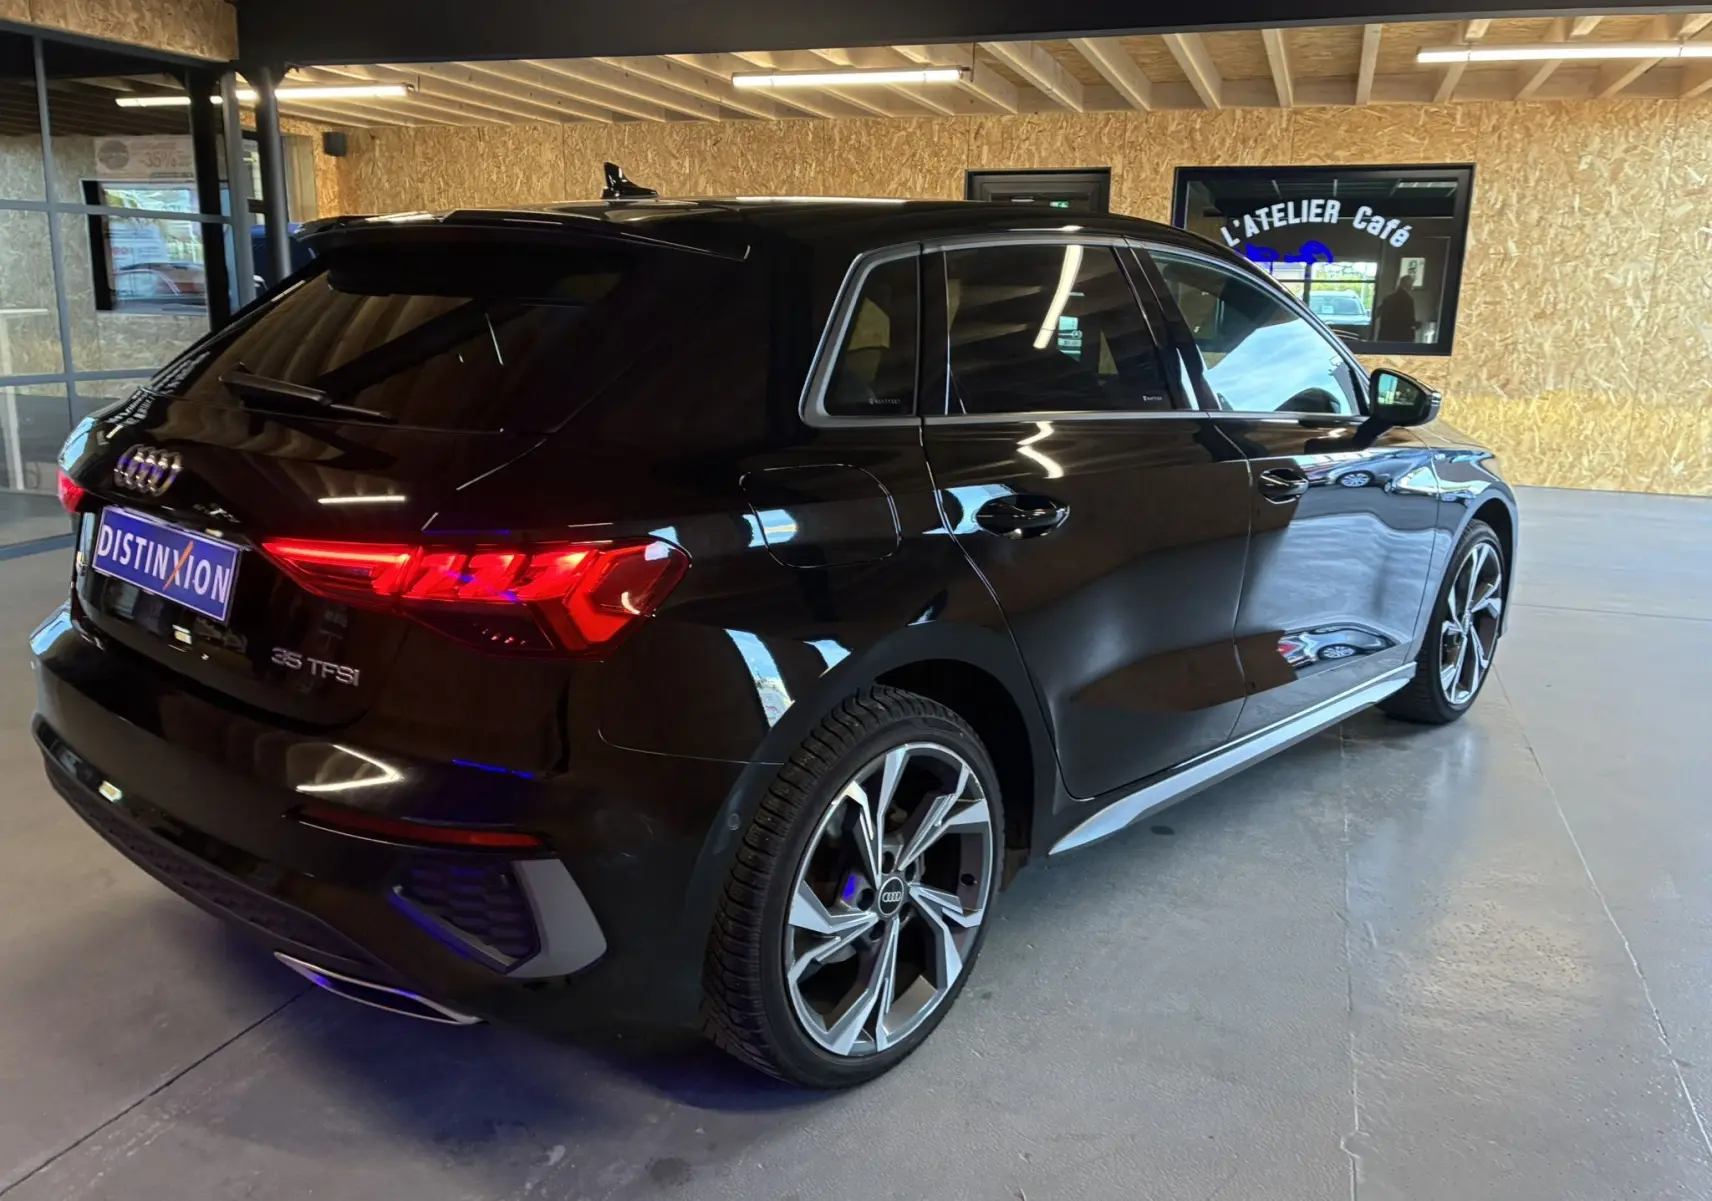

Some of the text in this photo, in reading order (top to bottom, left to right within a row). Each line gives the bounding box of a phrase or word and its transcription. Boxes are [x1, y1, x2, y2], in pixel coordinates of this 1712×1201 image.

[1220, 199, 1414, 248] L'ATELIER Café
[97, 524, 231, 604] DISTINXION
